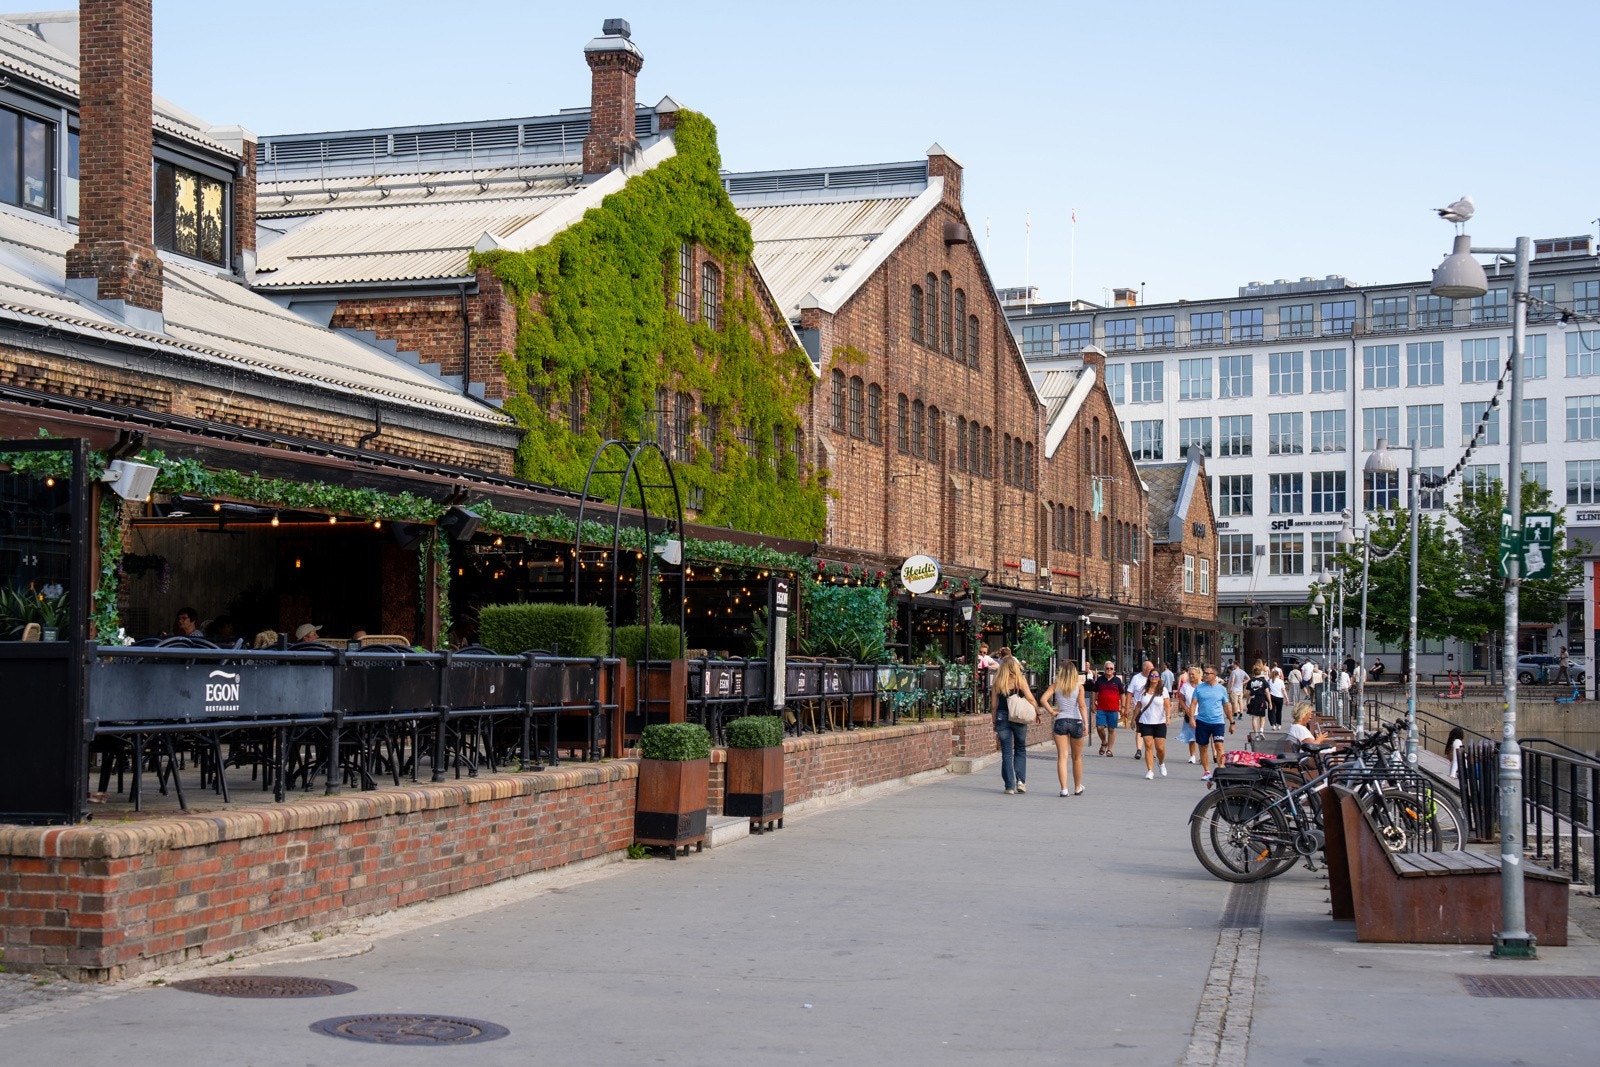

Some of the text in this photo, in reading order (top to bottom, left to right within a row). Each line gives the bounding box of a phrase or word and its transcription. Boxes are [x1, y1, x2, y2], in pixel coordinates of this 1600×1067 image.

[1271, 521, 1289, 530] SFL
[903, 563, 936, 577] Heidi's
[205, 684, 239, 701] EGON
